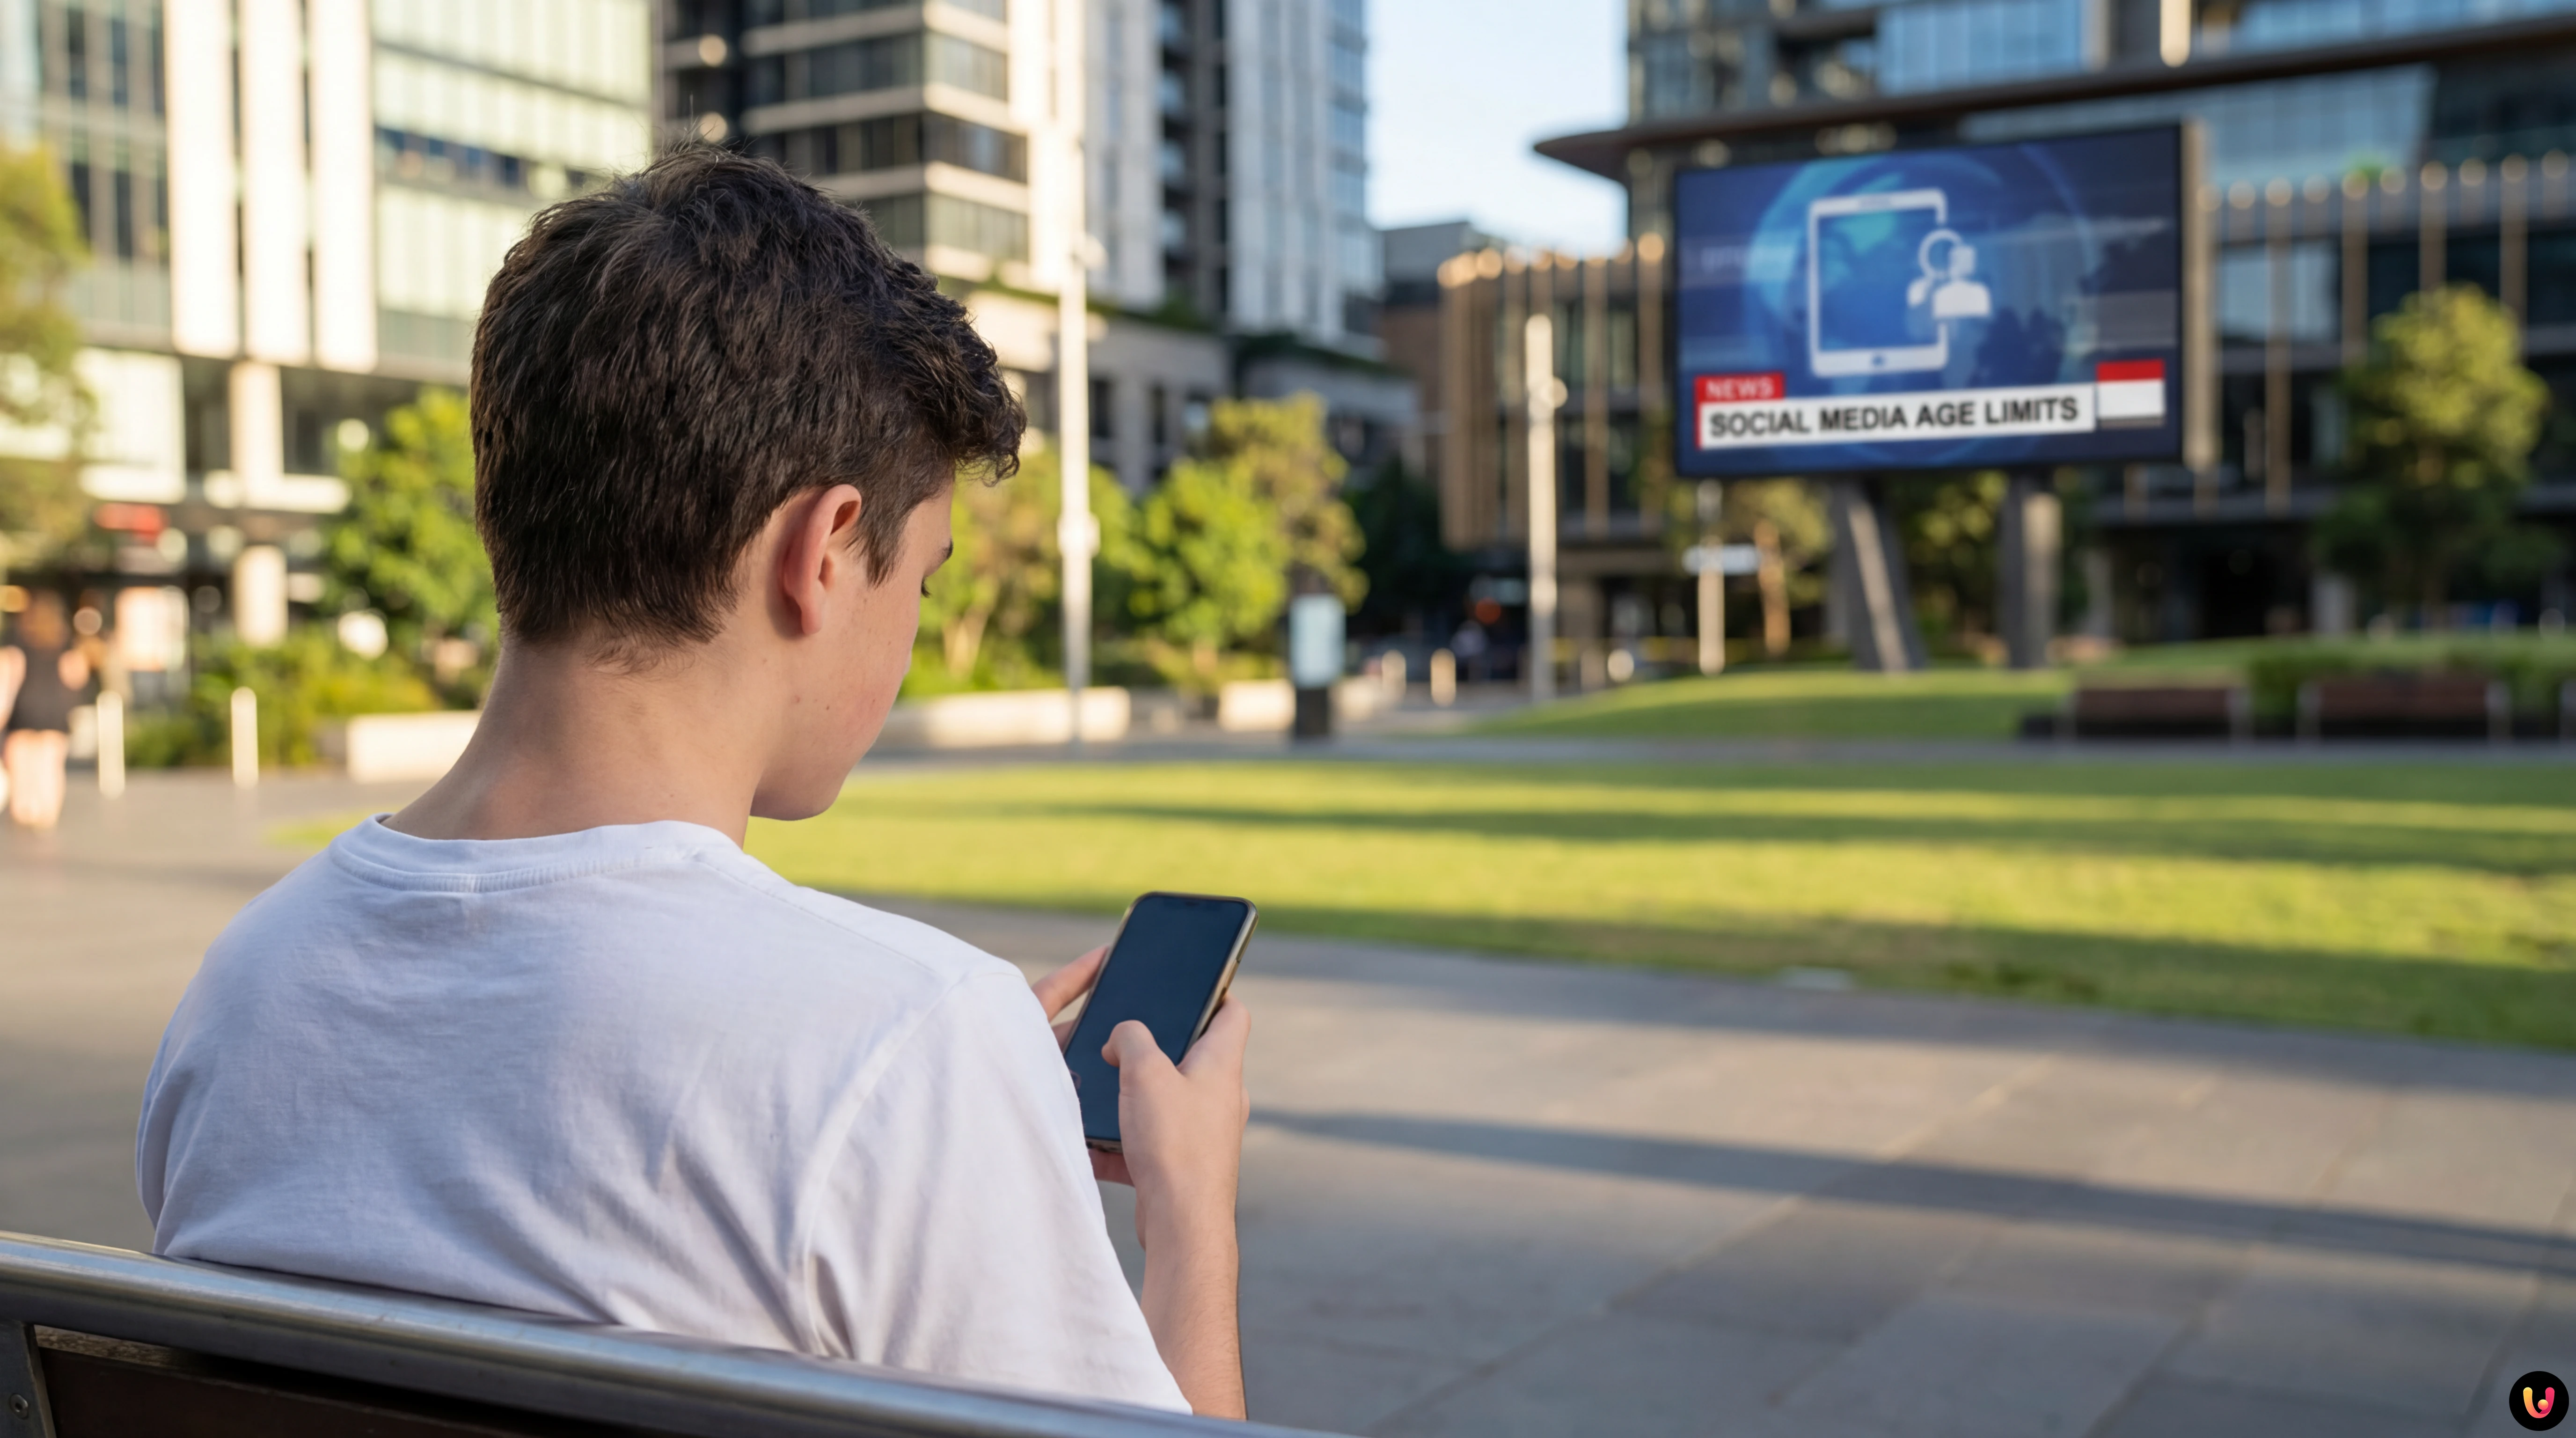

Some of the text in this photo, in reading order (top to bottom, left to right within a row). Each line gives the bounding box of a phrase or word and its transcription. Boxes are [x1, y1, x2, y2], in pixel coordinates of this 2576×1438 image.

[1705, 376, 1774, 399] NEWS
[1710, 396, 2078, 438] SOCIAL MEDIA AGE LIMITS
